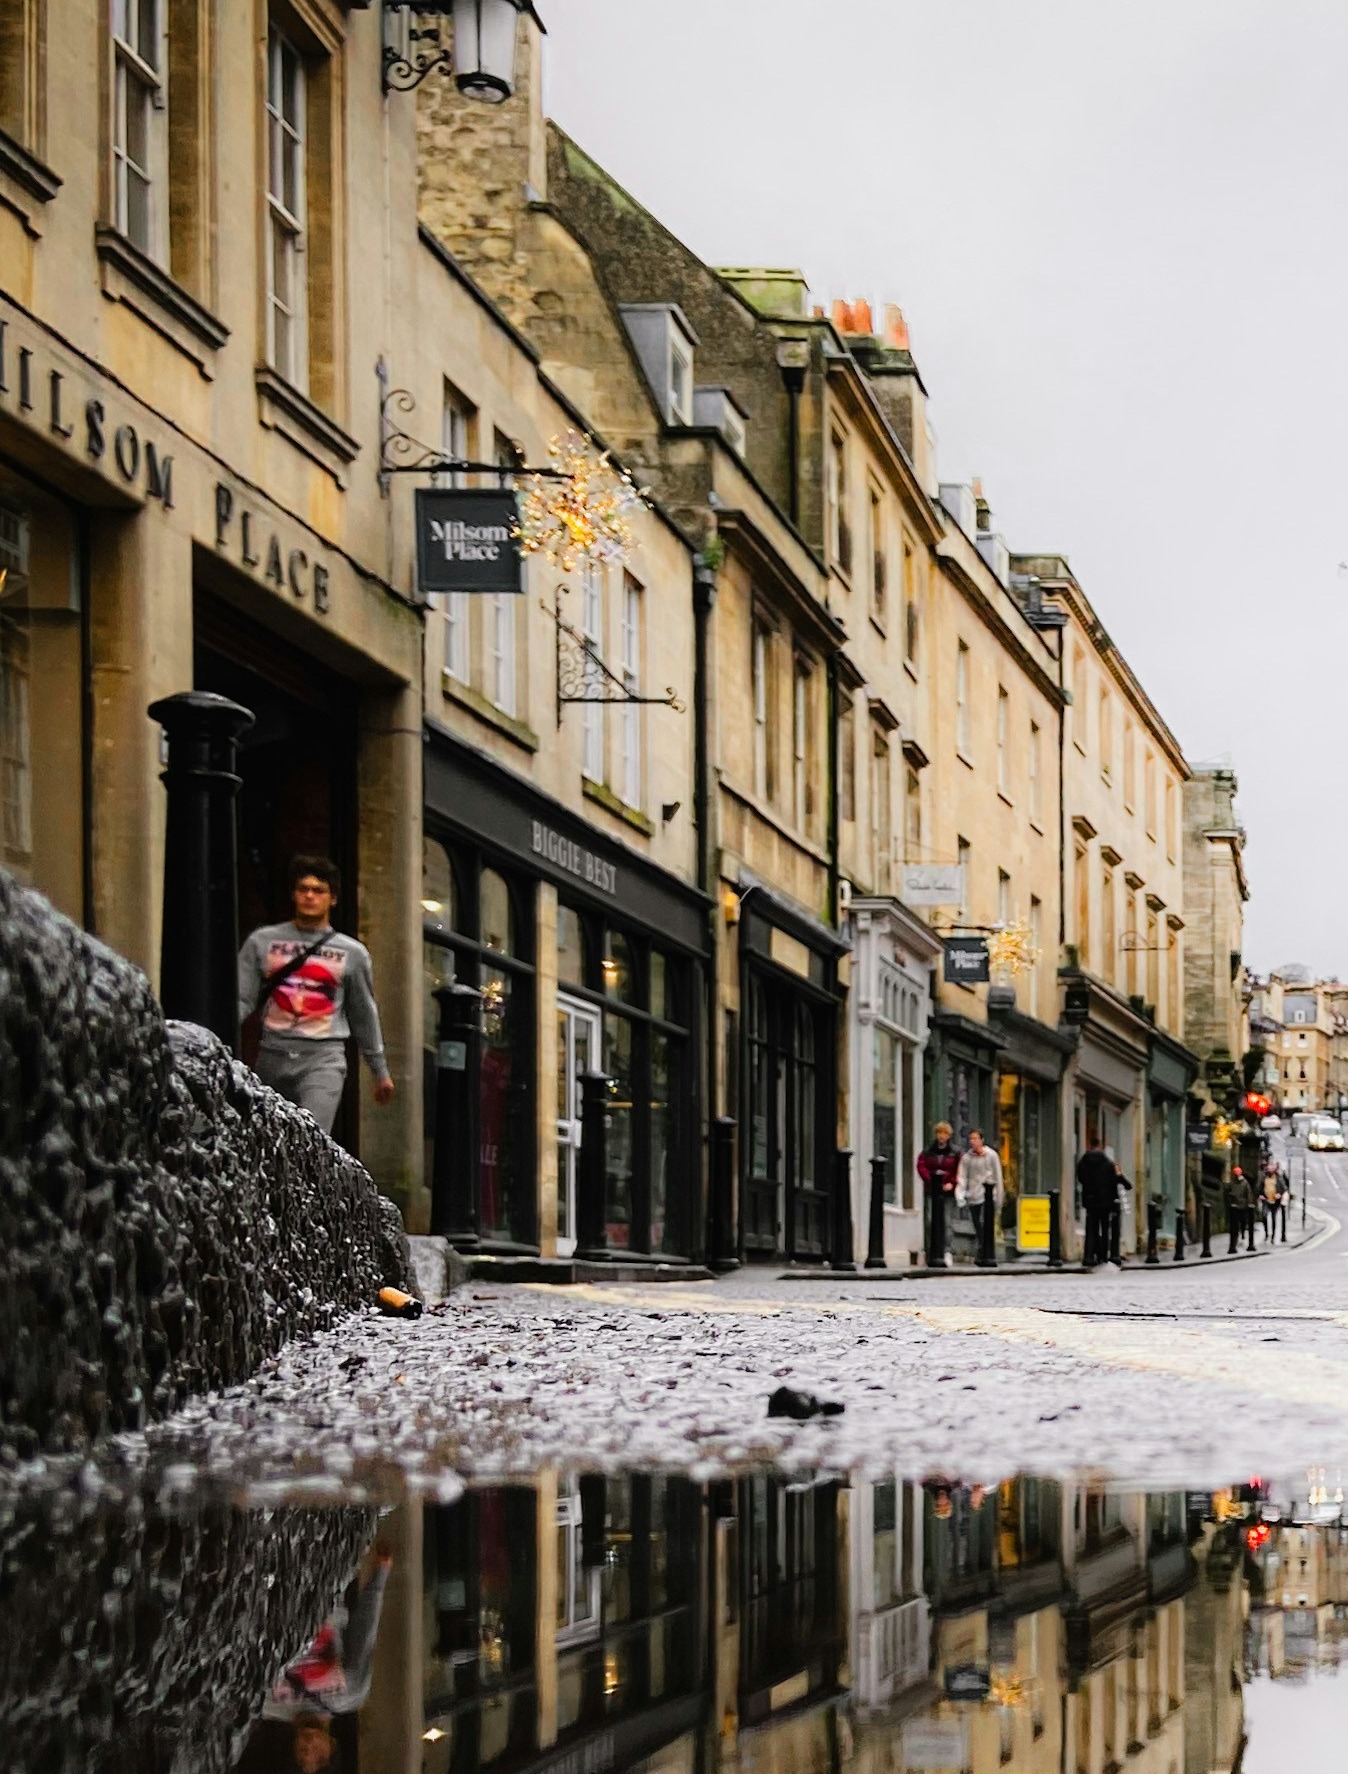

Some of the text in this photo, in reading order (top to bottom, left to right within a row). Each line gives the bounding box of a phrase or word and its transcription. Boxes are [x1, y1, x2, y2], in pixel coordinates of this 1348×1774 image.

[215, 482, 329, 614] PLACE
[430, 520, 509, 541] Milsom
[445, 541, 500, 560] Place
[533, 820, 617, 895] BIGGIE BEST
